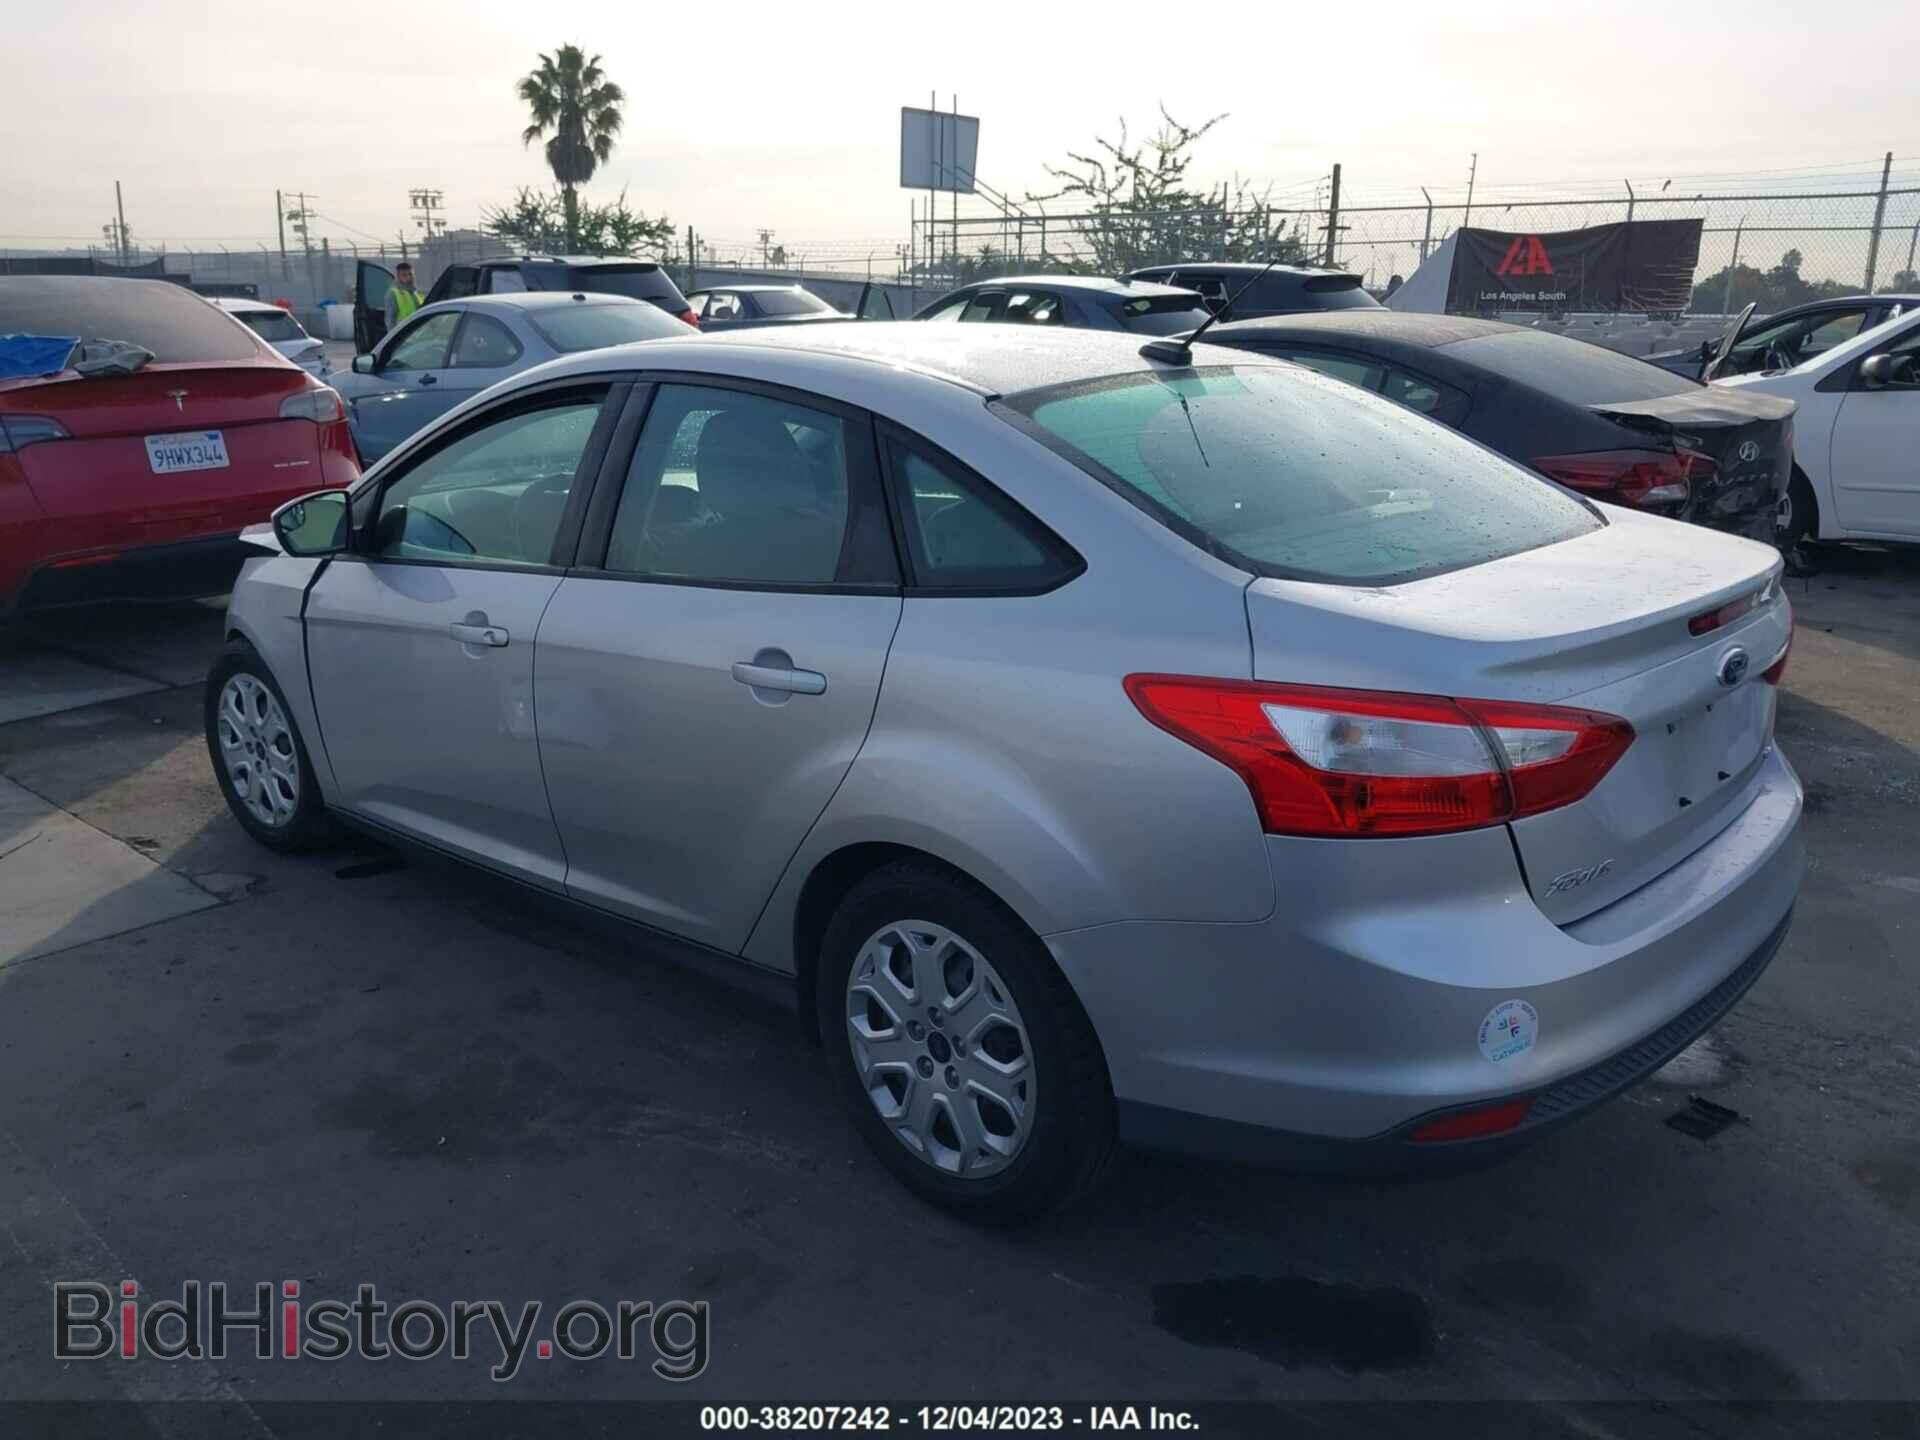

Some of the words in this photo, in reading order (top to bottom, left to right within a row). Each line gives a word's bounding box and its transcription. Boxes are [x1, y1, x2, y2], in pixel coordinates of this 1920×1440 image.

[1481, 291, 1497, 300] Los
[1500, 291, 1536, 302] Angeles
[1538, 291, 1566, 300] South
[154, 444, 222, 467] 9HWX344
